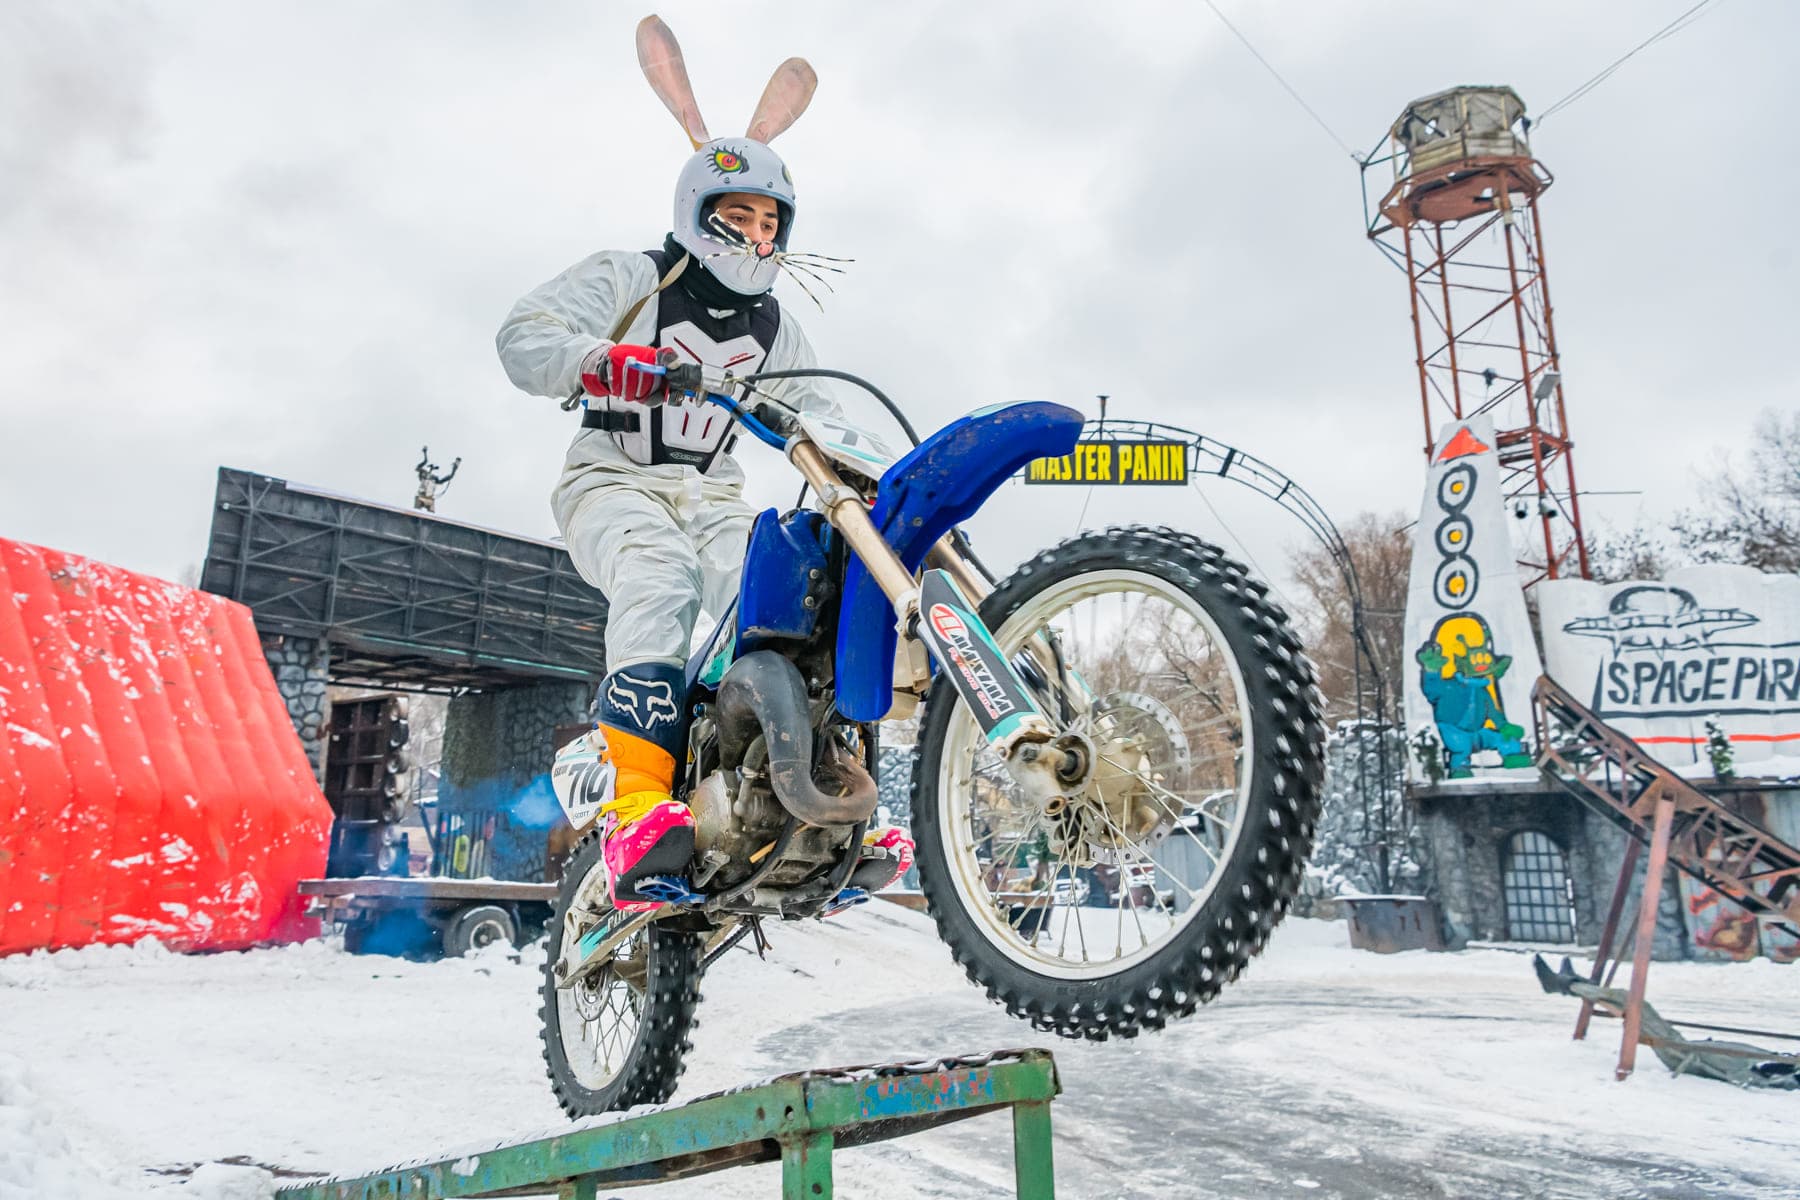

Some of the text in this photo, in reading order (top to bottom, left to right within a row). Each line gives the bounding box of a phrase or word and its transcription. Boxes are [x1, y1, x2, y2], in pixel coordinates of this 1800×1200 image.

[1030, 444, 1184, 485] MASTER PANIN
[568, 762, 608, 808] 710
